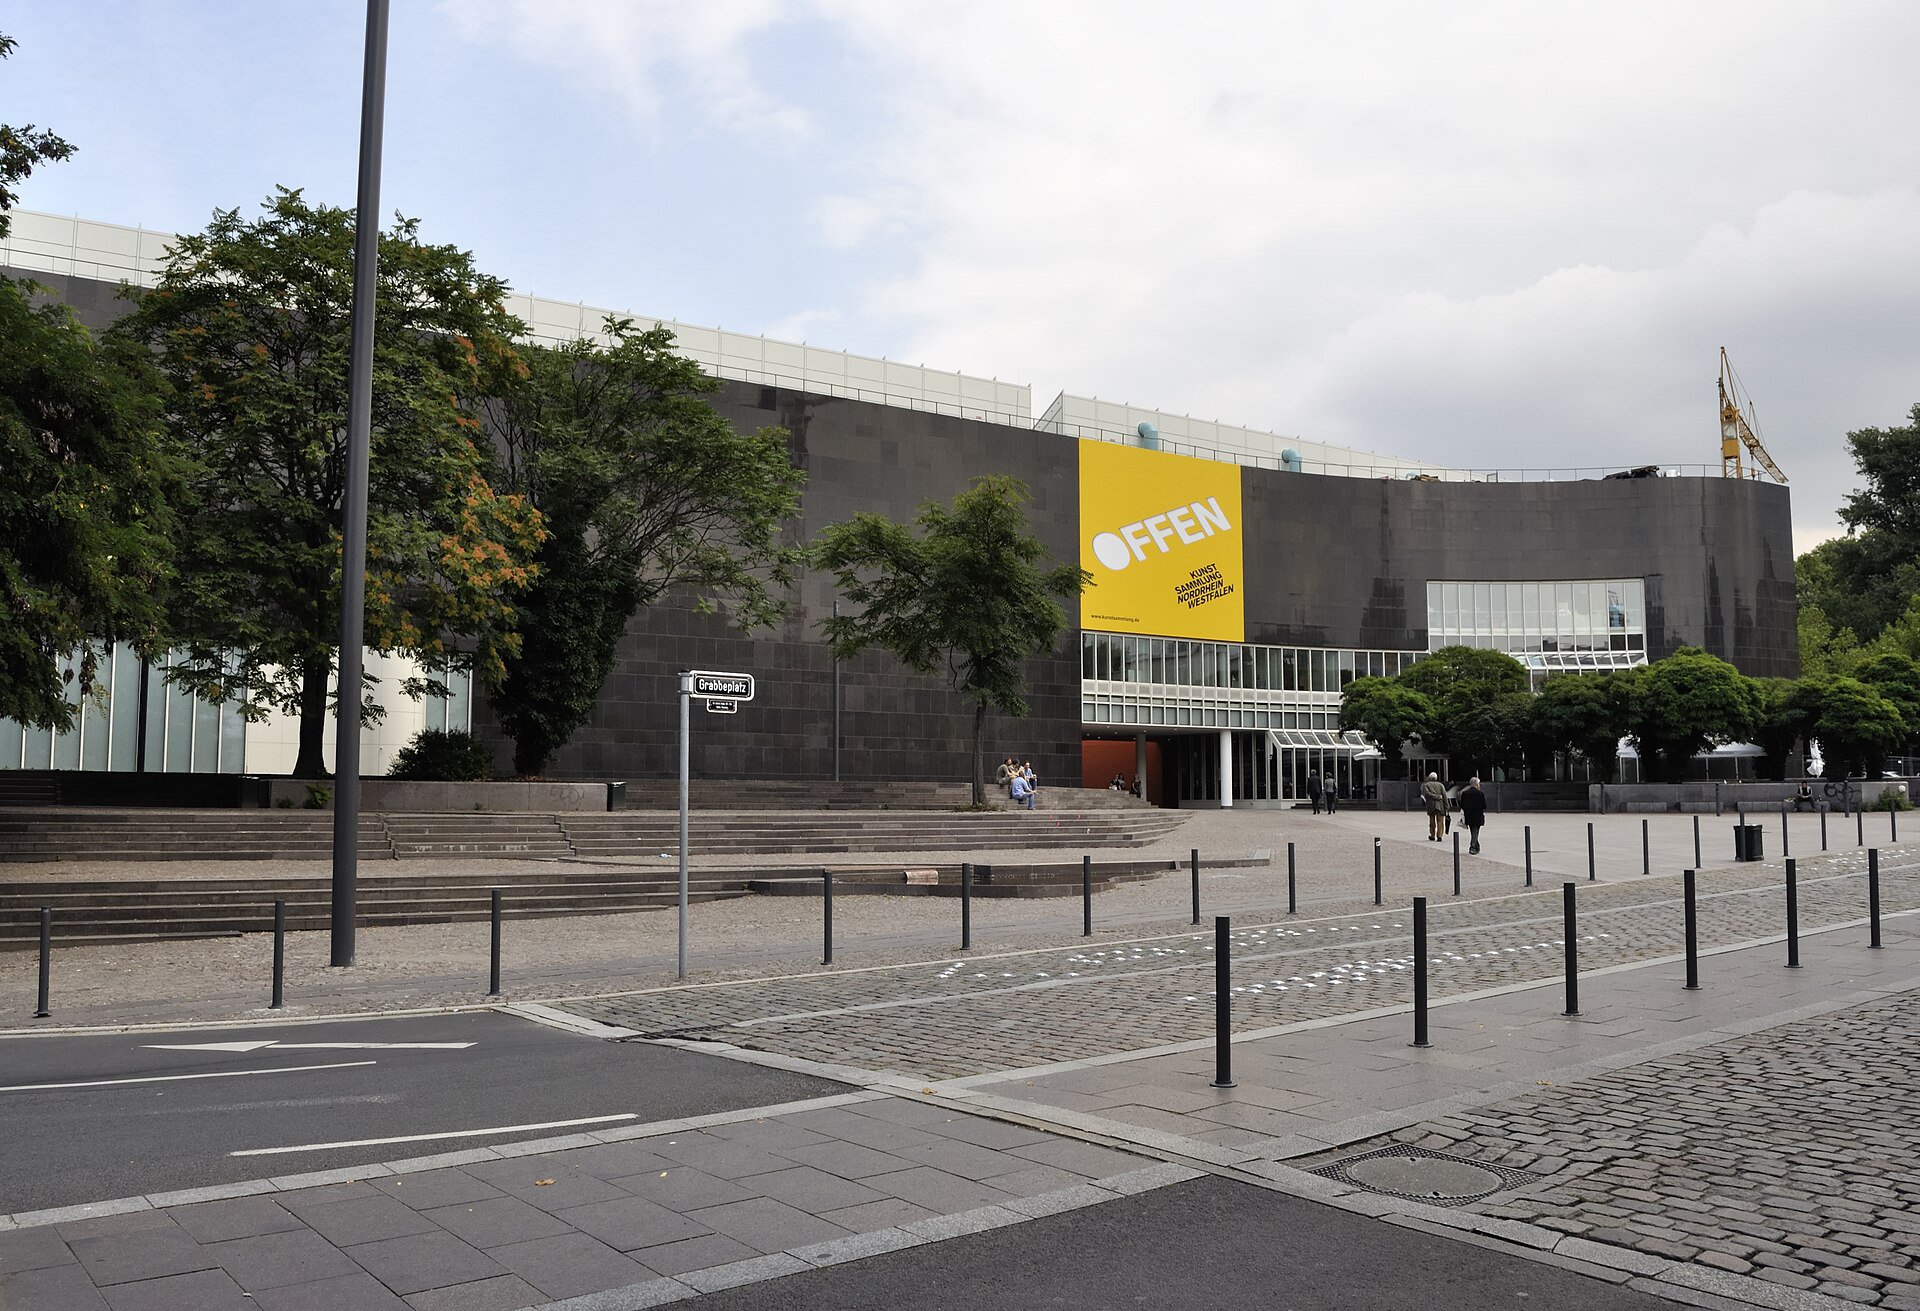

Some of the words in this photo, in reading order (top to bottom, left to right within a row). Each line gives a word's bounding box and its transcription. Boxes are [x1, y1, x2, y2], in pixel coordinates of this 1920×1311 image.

[1092, 496, 1232, 571] OFFEN
[1175, 571, 1222, 594] SAMMLUNG
[1190, 563, 1217, 579] KUNST
[1178, 579, 1223, 604] NORDRHEIN
[1188, 584, 1234, 609] WESTFALEN
[699, 679, 746, 693] Grabbeplatz
